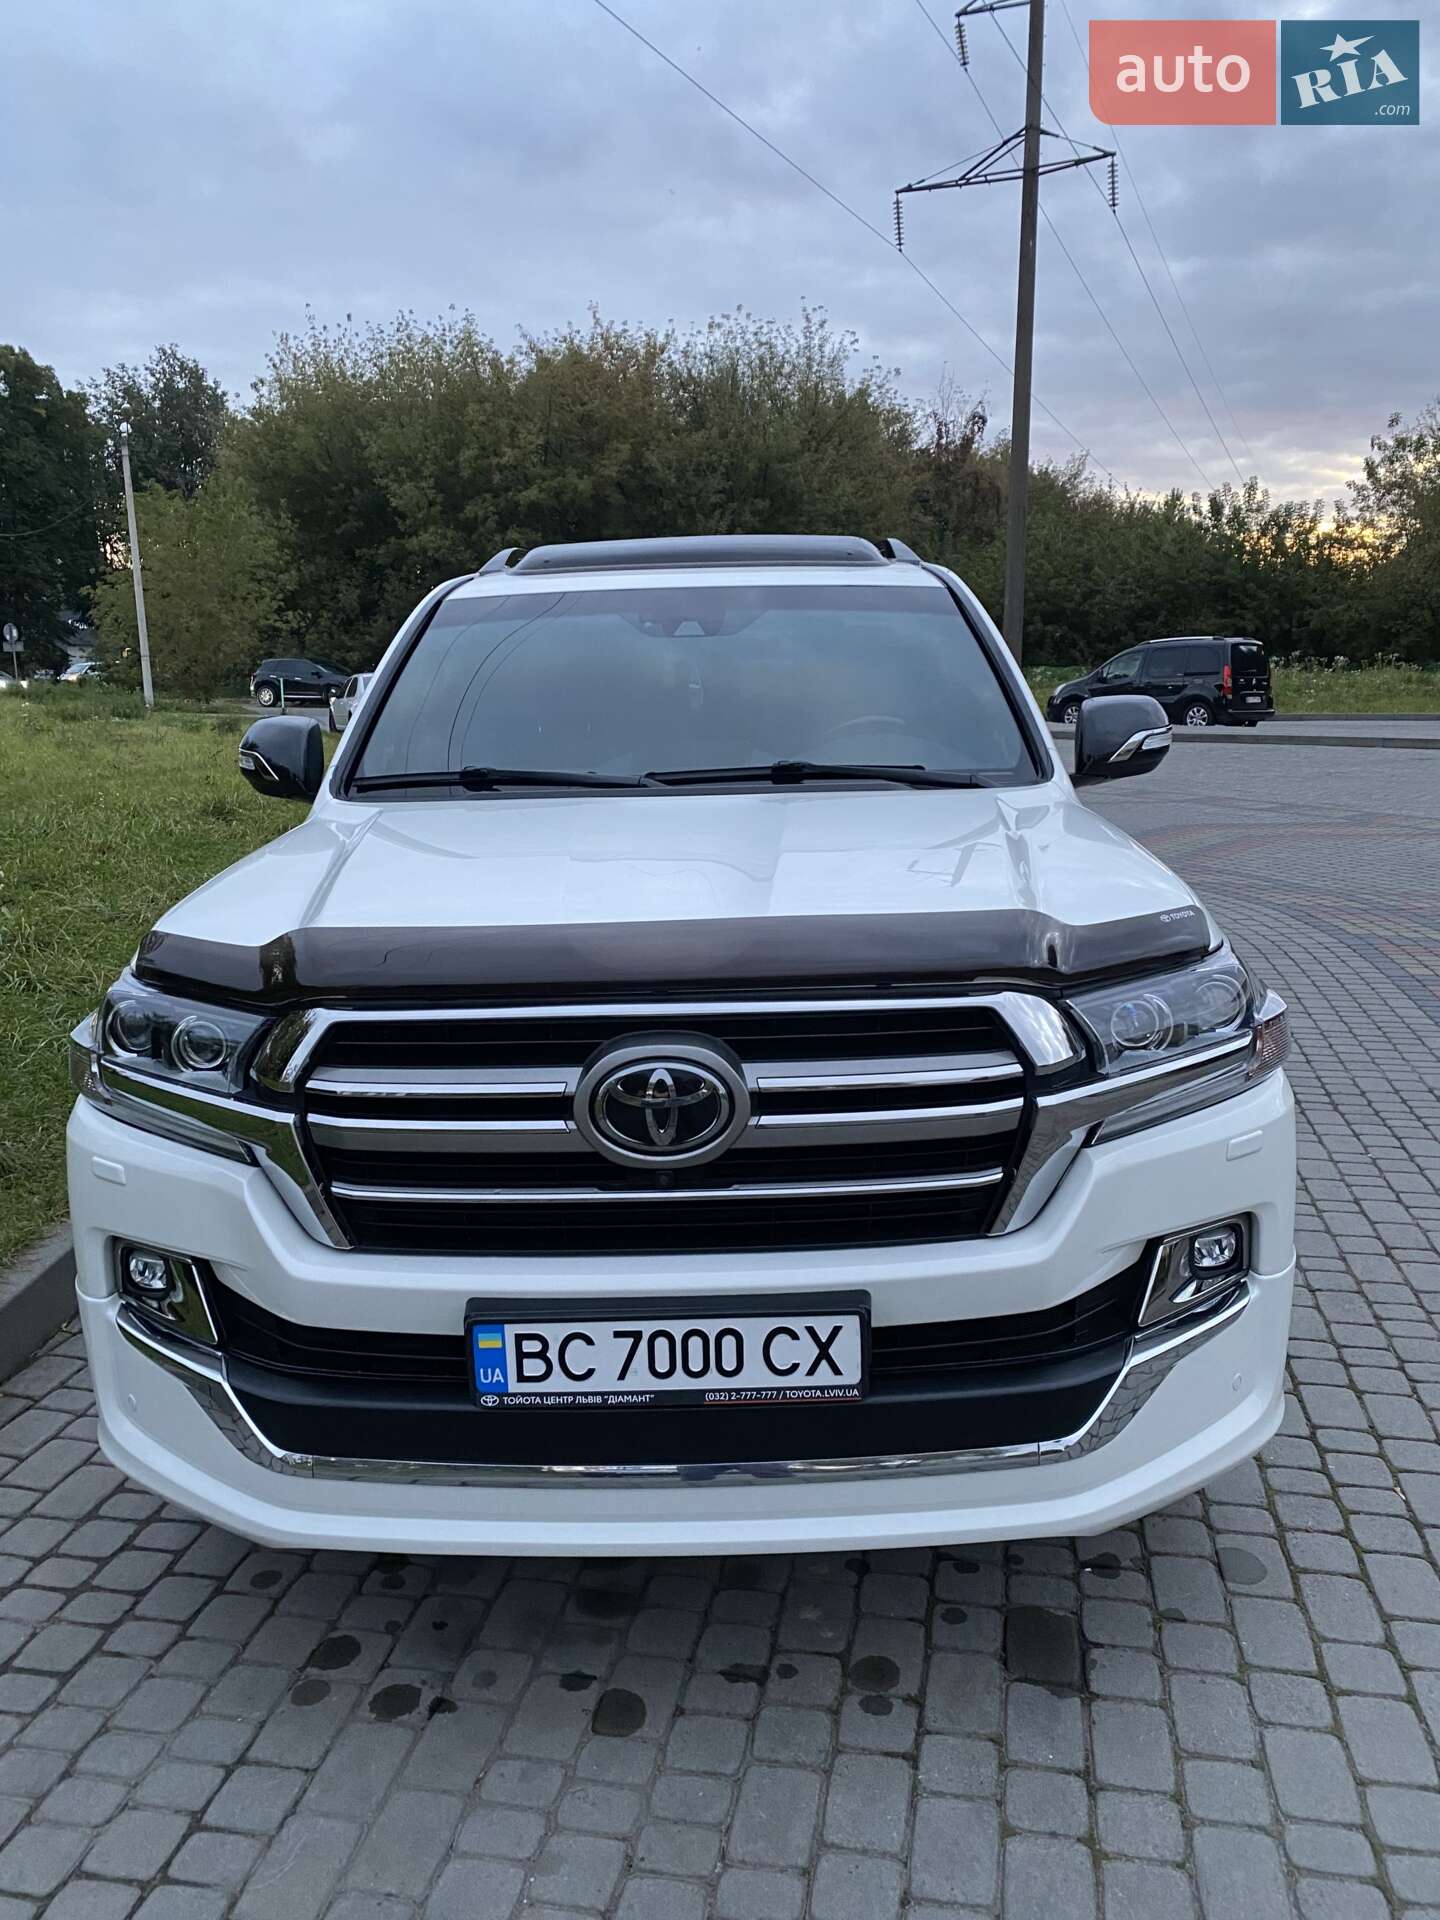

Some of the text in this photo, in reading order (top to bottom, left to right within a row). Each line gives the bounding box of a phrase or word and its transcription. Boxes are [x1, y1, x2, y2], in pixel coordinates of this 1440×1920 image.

[1169, 910, 1195, 920] TOYOTA
[514, 1325, 844, 1383] BC 7000 CX
[480, 1368, 504, 1383] UA
[503, 1395, 541, 1405] ТОЙОТА
[543, 1396, 574, 1405] ЦЕНТР
[575, 1396, 603, 1404] ЛЬВІВ
[705, 1392, 729, 1401] (032)
[730, 1391, 777, 1400] 2-777-777
[785, 1388, 859, 1398] TOYOTA.LVIV.UA
